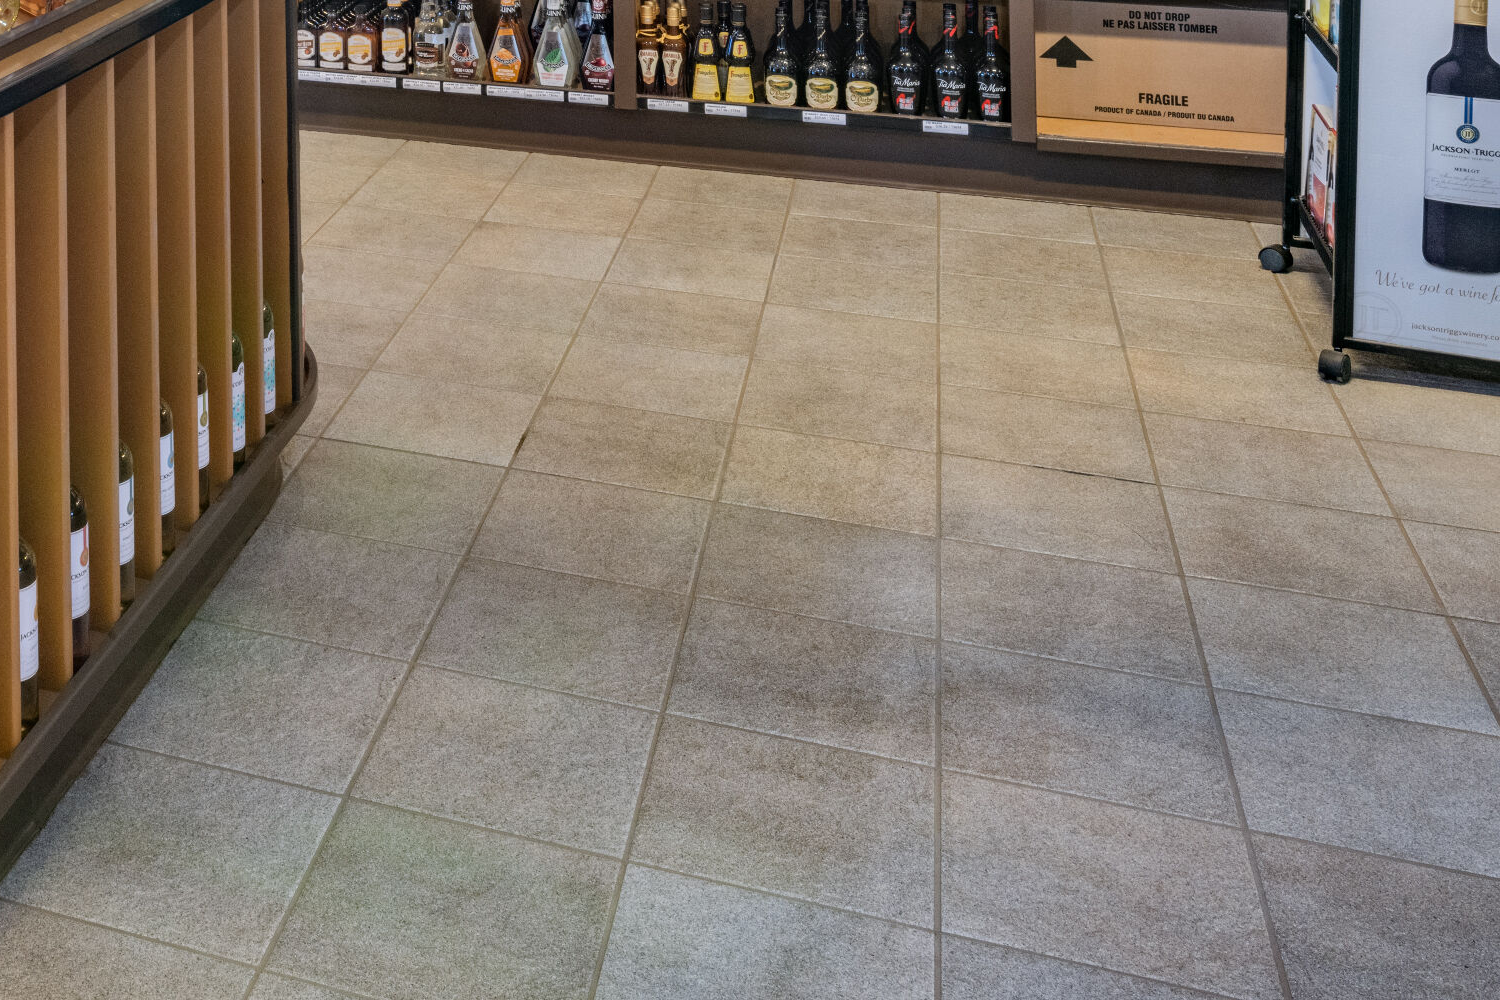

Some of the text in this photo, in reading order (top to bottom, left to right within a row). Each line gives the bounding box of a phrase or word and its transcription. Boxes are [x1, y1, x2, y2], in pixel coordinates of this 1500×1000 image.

[1128, 10, 1190, 22] DO NOT DROP
[1102, 19, 1218, 34] NE PAS LAISSER TOMBER
[891, 76, 920, 86] Tia Maria
[937, 78, 965, 89] Tia Maria
[987, 84, 1006, 92] Maria
[1138, 92, 1189, 107] FRAGILE
[1094, 106, 1124, 114] PRODUCT
[1135, 109, 1162, 117] CANADA
[1167, 111, 1195, 119] PRODUIT
[1207, 114, 1235, 122] CANADA
[1375, 269, 1415, 290] We've
[1420, 283, 1441, 296] got
[1445, 287, 1454, 296] a
[1459, 286, 1488, 301] wine
